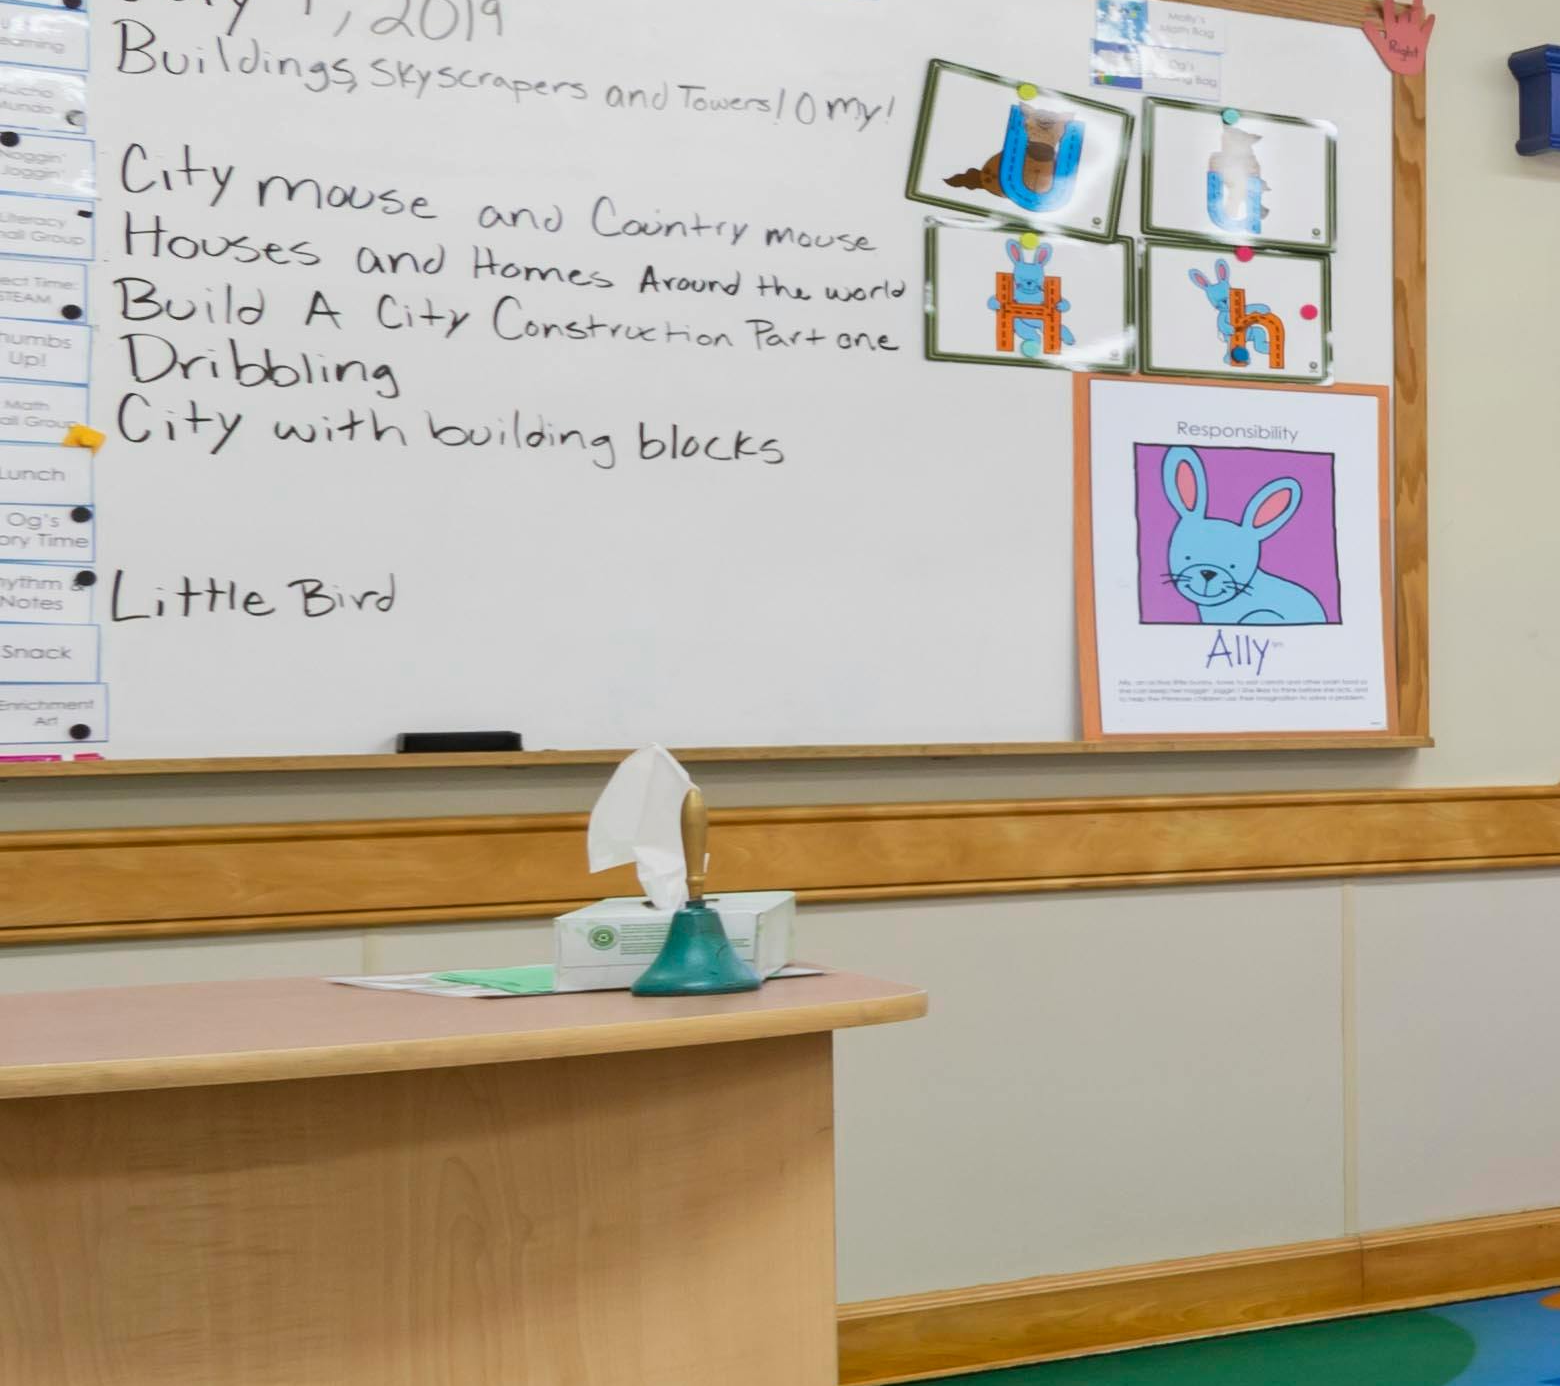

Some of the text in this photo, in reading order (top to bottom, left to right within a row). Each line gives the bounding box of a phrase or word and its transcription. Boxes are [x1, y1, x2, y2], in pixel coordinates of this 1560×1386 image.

[1388, 40, 1418, 61] Right
[371, 46, 589, 104] Skyscrapers
[606, 82, 668, 113] and
[121, 142, 877, 252] City mouse and Country mouse
[32, 231, 86, 245] Group
[125, 212, 906, 303] Houses and Homes Around the world
[115, 277, 899, 353] Build A City Construction Part one
[996, 272, 1061, 354] H
[1229, 288, 1285, 369] h
[9, 350, 47, 368] Up!
[122, 332, 402, 399] Dribbling
[4, 399, 50, 412] Math
[117, 392, 786, 471] City with building blocks
[1177, 419, 1299, 444] Responsibility
[7, 513, 60, 531] Og's
[38, 533, 89, 549] Time
[0, 596, 64, 611] Notes
[111, 569, 398, 623] Little Bird
[2, 645, 72, 660] Snack
[1206, 629, 1270, 676] Ally
